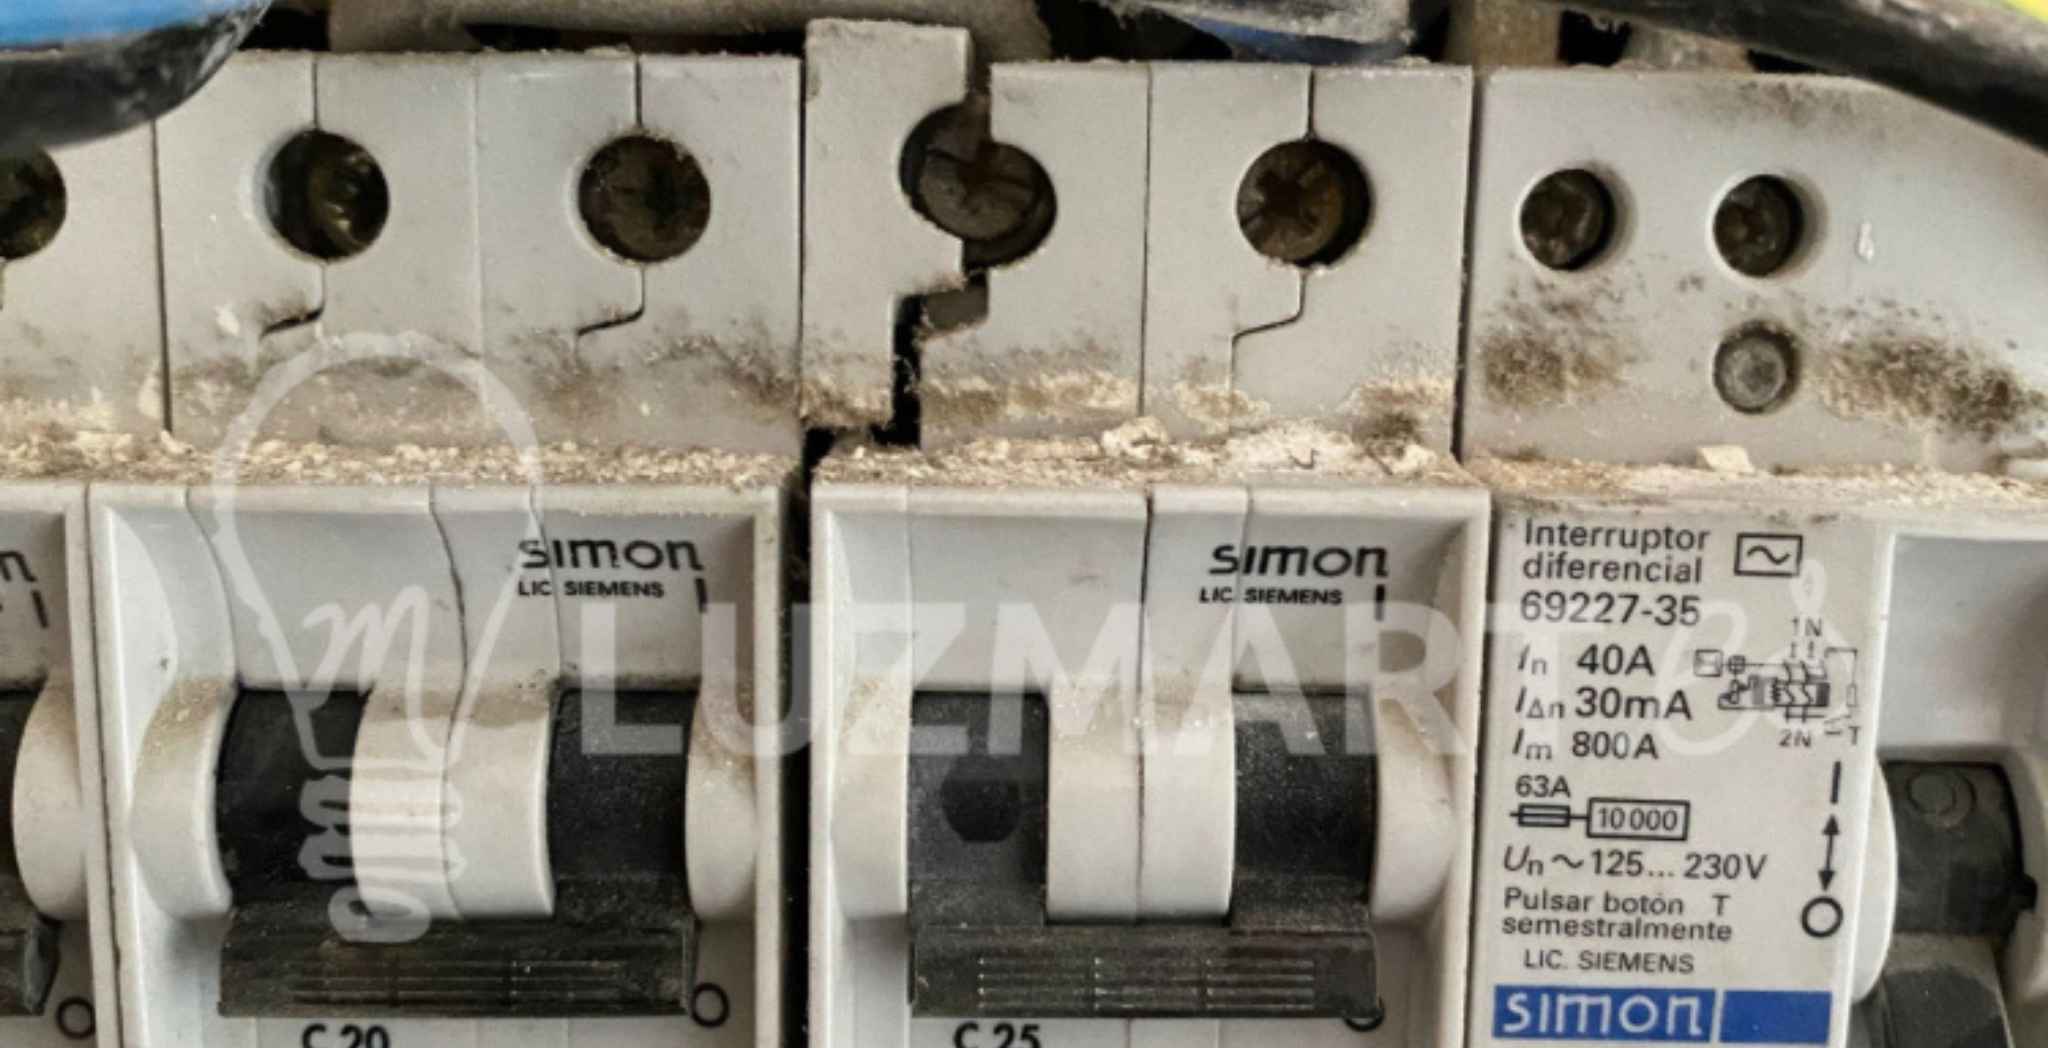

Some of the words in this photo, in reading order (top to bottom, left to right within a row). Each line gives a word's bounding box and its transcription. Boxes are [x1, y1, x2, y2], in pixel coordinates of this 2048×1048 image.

[1524, 518, 1711, 554] Interruptor
[518, 538, 705, 570] simon
[1209, 544, 1388, 577] simon
[1523, 551, 1702, 584] diferencial
[564, 580, 664, 598] SIEMENS
[1244, 587, 1343, 605] SIEMENS
[1520, 590, 1699, 626] 69227-35
[1576, 644, 1655, 676] 40A
[1575, 687, 1693, 721] 30mA
[1571, 731, 1660, 760] 800A
[1515, 775, 1571, 798] 63A
[1683, 852, 1768, 880] 230V
[1503, 885, 1594, 914] Pulsar
[1711, 893, 1732, 917] T
[1501, 914, 1733, 943] semestralmente
[1577, 950, 1696, 975] SIEMENS
[1503, 991, 1704, 1036] simon
